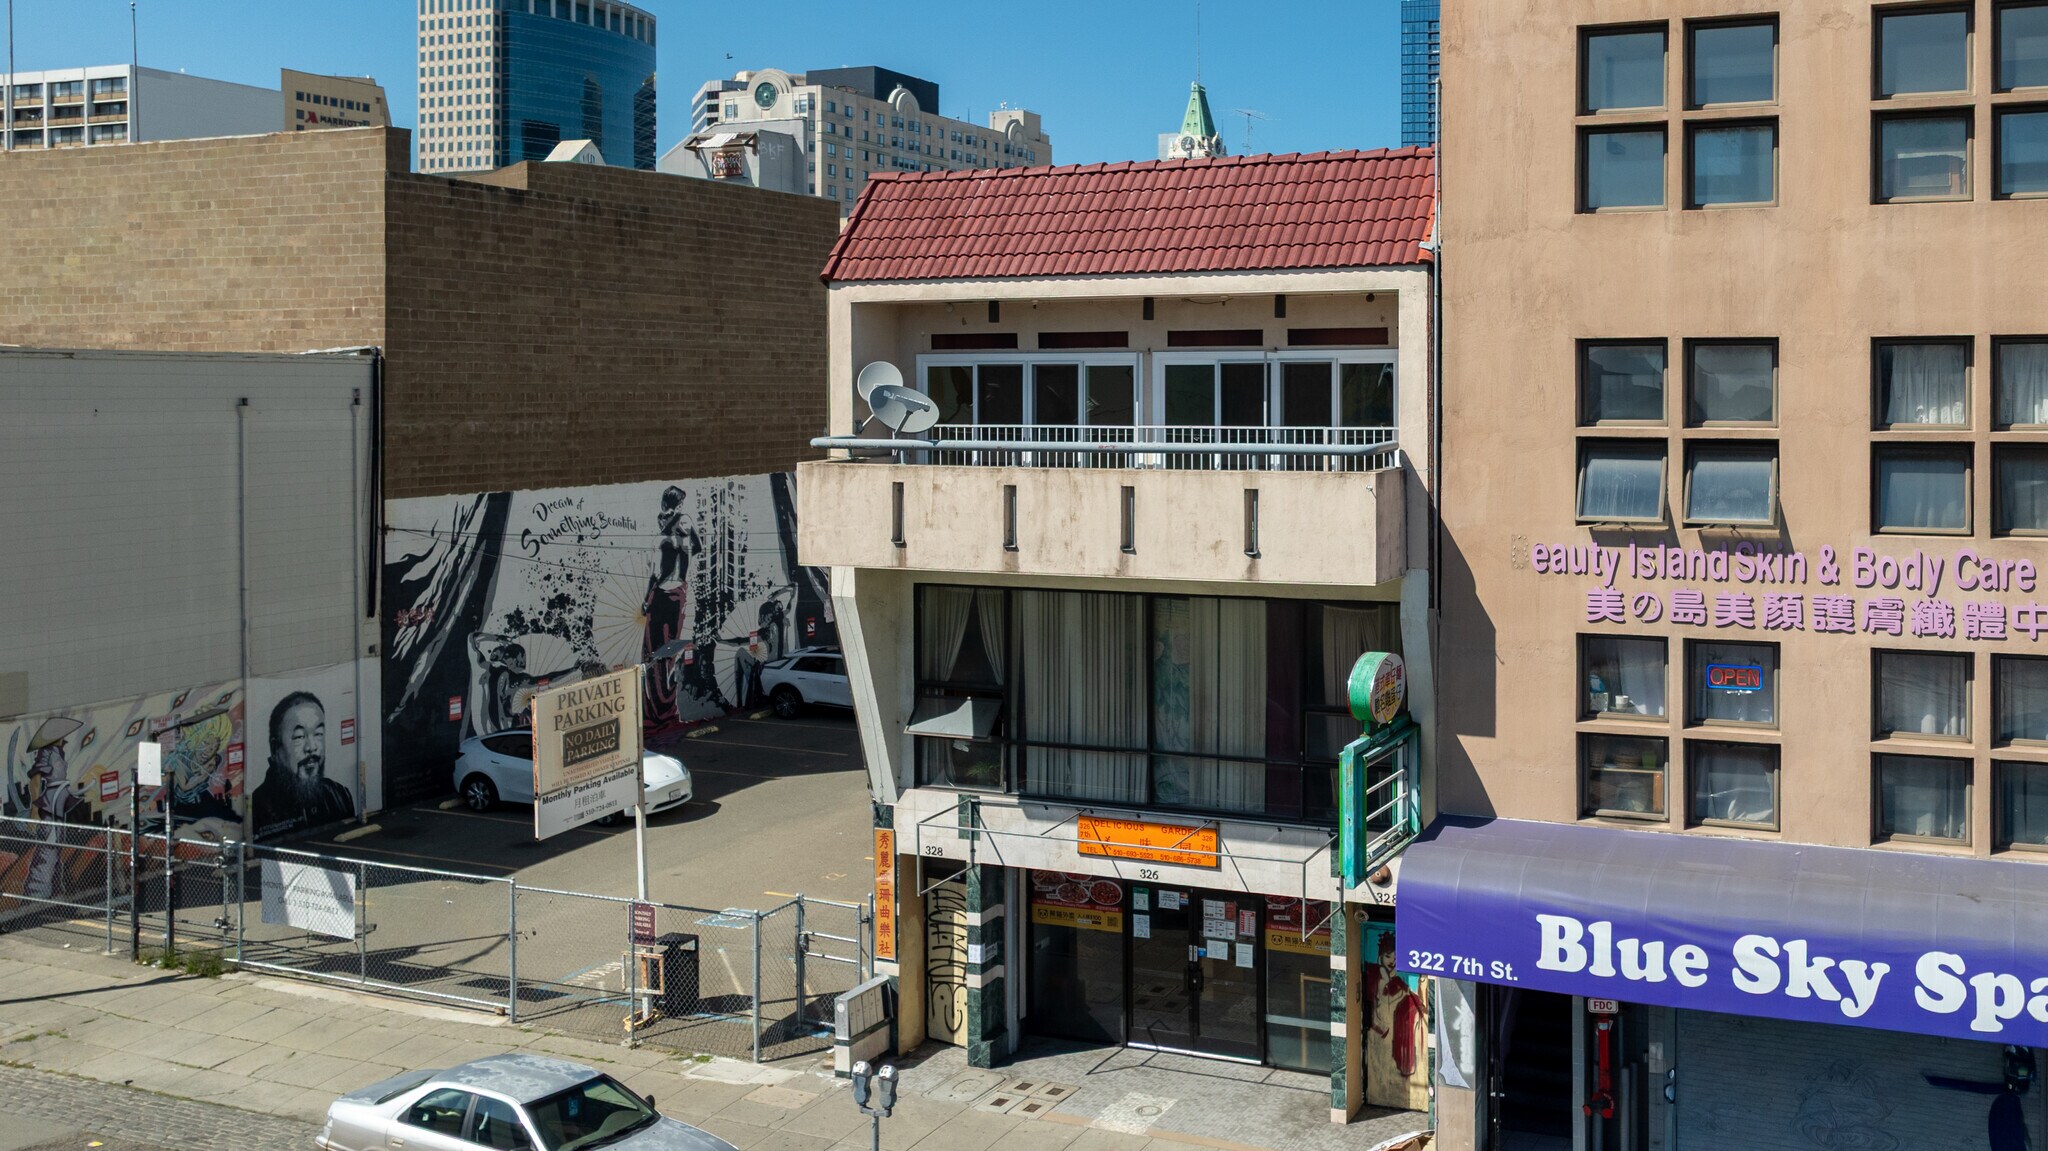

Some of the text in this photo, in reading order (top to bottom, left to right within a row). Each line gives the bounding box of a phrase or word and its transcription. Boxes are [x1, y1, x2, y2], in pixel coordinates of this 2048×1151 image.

[320, 115, 363, 127] MARRIOTT
[533, 497, 573, 522] Dream
[521, 511, 637, 558] Something Beautiful
[1629, 537, 1729, 580] Island
[1735, 540, 1807, 583] Skin
[1816, 544, 1840, 584] &
[1853, 546, 1944, 597] Body
[1953, 548, 2036, 592] Care
[1709, 667, 1760, 687] OPEN
[557, 678, 622, 710] PRIVATE
[554, 696, 625, 732] PARKING
[565, 722, 617, 748] NO DAILY
[567, 737, 616, 762] PARKING
[542, 768, 635, 805] Monthly Parking Available
[1094, 820, 1201, 837] DELICIOUS GARDEN
[925, 845, 943, 857] 328
[1140, 869, 1159, 880] 326
[1408, 950, 1519, 981] 322 7th St.
[1536, 914, 1709, 987] Blue
[1732, 934, 1890, 1018] Sky
[1593, 1001, 1613, 1010] FDC
